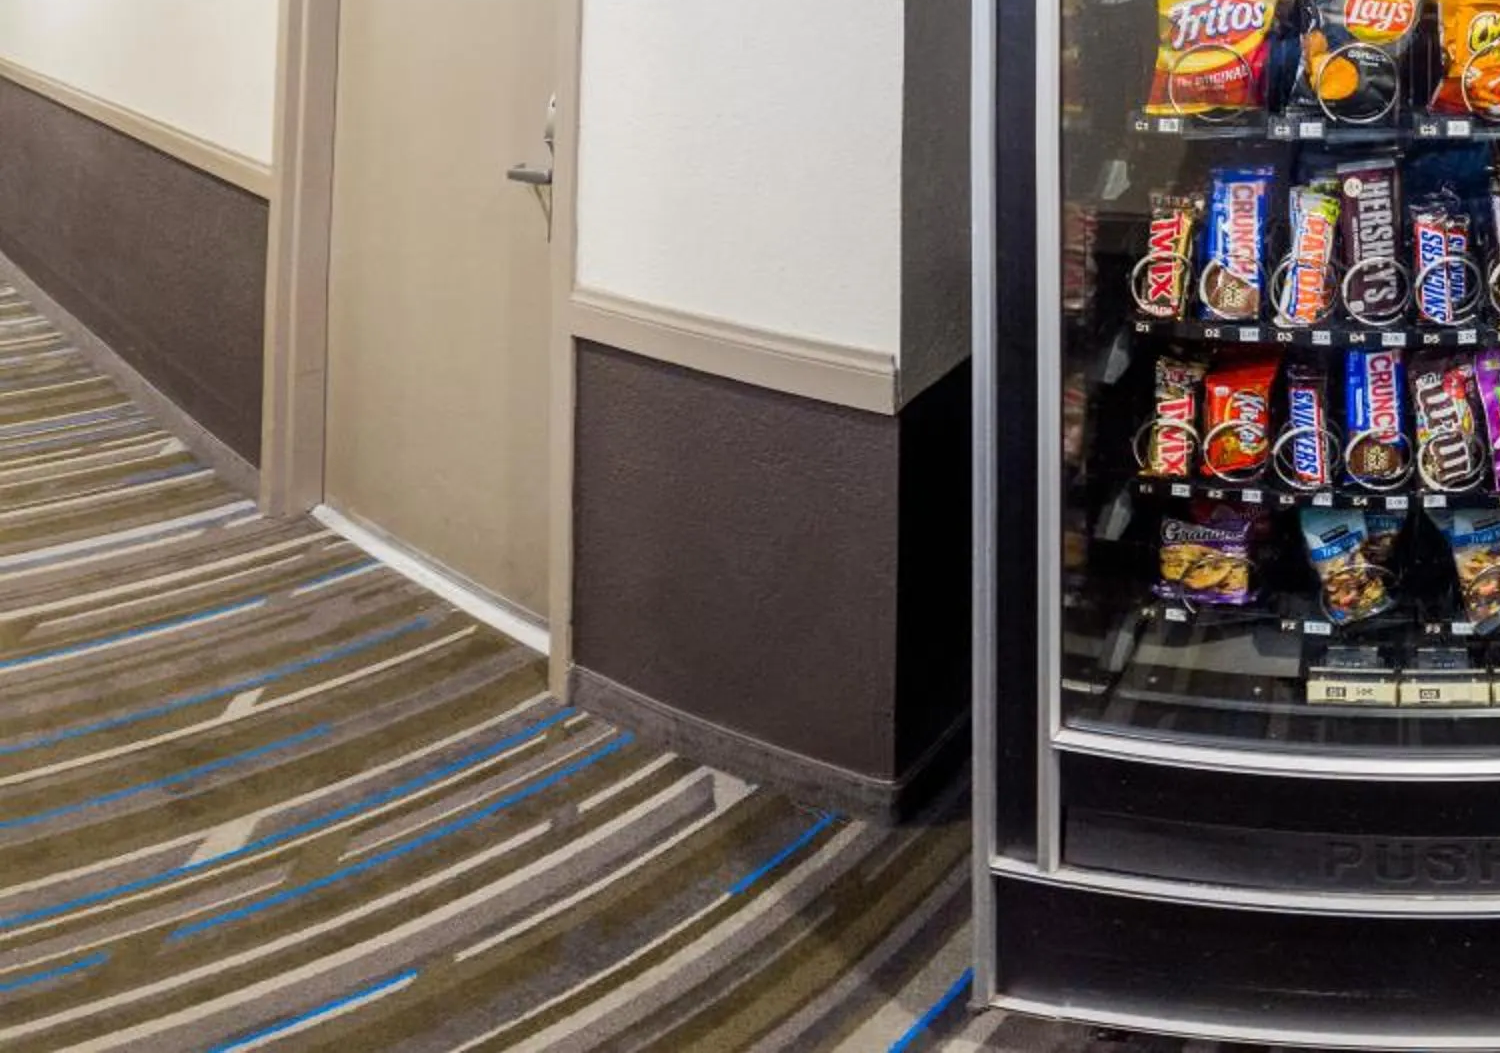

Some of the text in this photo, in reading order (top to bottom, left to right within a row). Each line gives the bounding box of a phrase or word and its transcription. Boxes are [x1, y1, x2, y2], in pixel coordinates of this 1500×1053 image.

[1151, 211, 1184, 300] TWIX
[1205, 327, 1220, 338] D2
[1277, 331, 1293, 341] D3
[1350, 332, 1365, 342] D4
[1423, 334, 1440, 344] D5
[1368, 353, 1399, 444] CRUNCH
[1157, 393, 1195, 478] TWIX
[1293, 390, 1320, 475] SNICKERS
